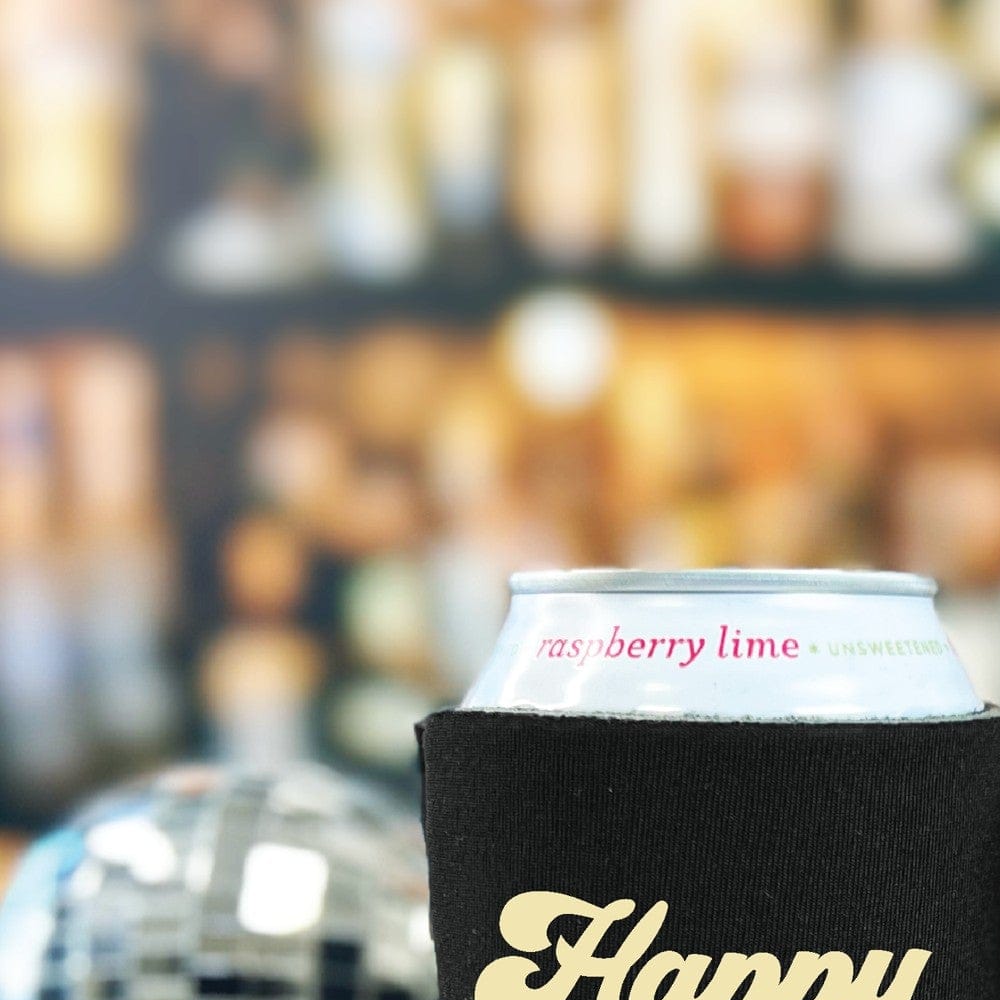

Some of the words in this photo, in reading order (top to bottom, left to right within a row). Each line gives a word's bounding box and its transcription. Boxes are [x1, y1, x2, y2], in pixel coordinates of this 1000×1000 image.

[536, 625, 706, 668] raspberry
[716, 624, 800, 659] lime
[828, 639, 944, 657] UNSWEETENED
